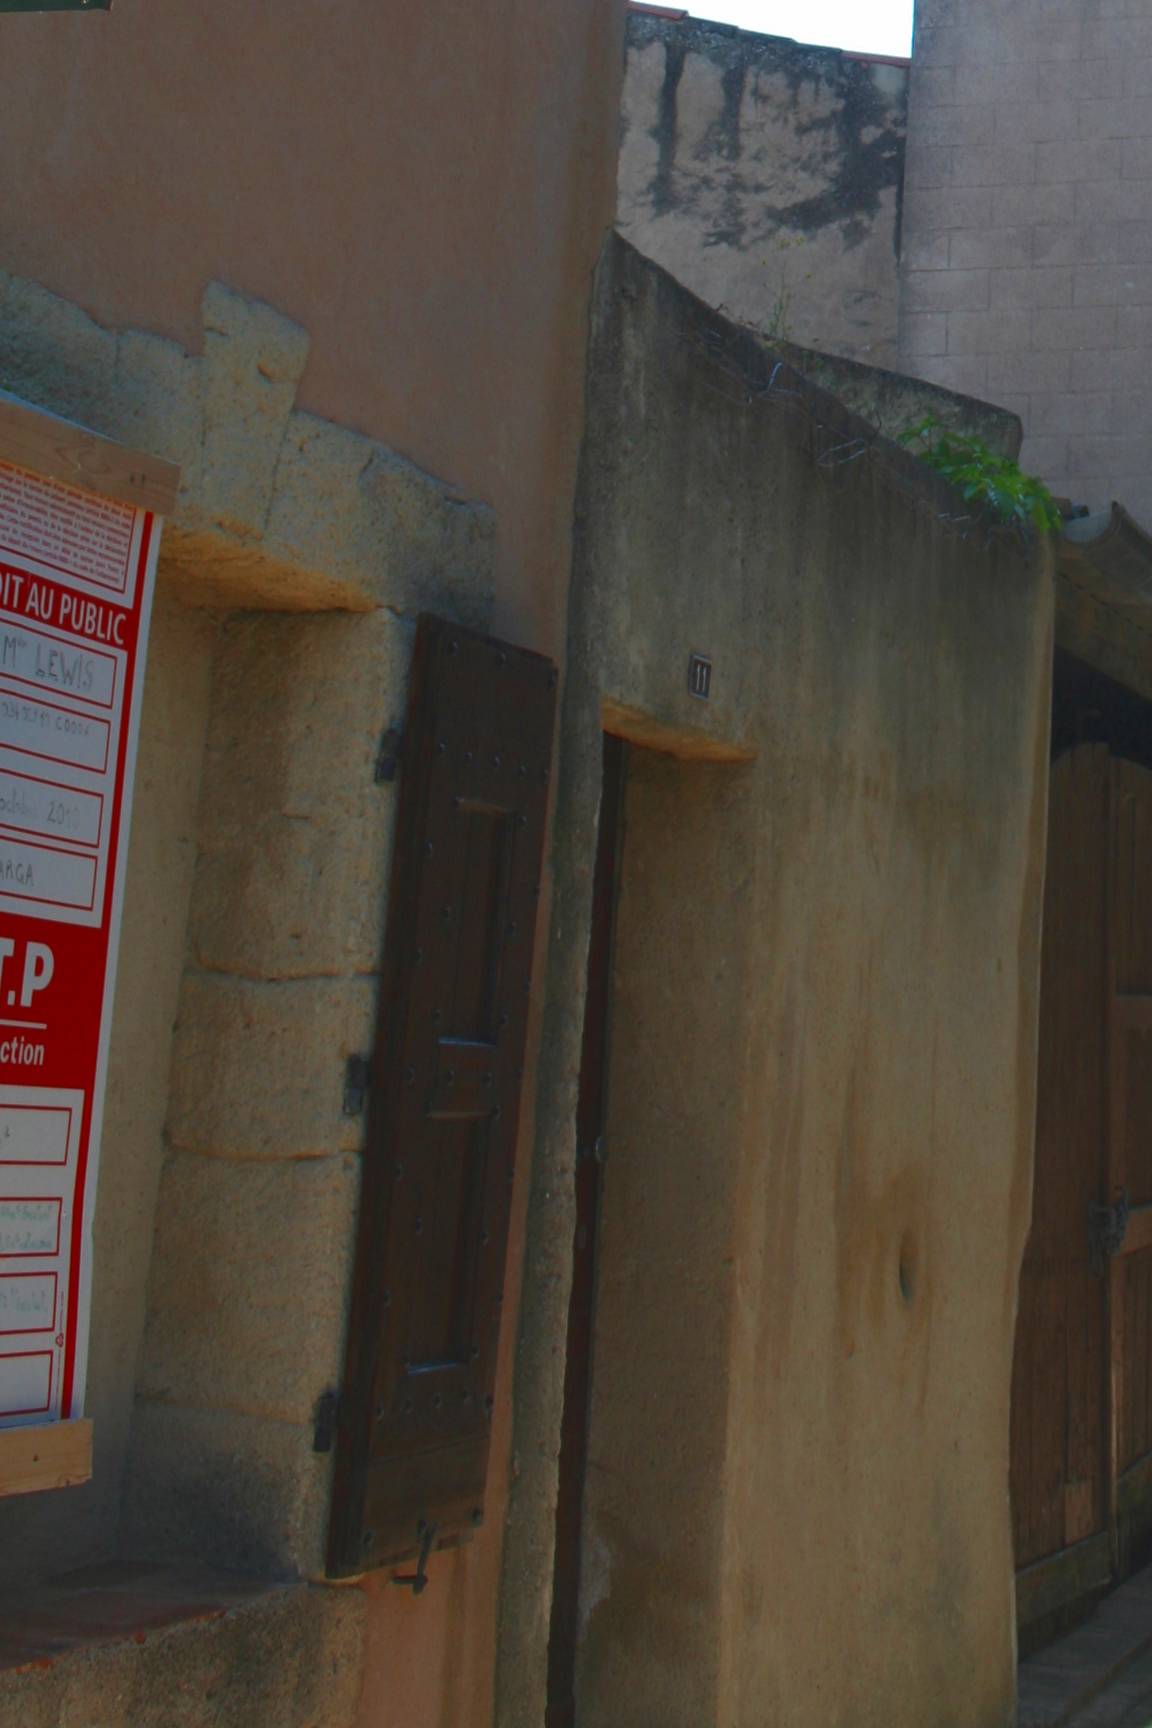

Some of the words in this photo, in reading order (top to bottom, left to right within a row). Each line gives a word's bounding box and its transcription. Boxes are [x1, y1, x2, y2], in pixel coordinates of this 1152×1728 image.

[0, 572, 24, 609] IT
[25, 582, 54, 620] AU
[59, 593, 127, 645] PUBLIC
[35, 642, 94, 690] LEWIS
[695, 663, 707, 692] 11
[0, 1035, 45, 1065] ction
